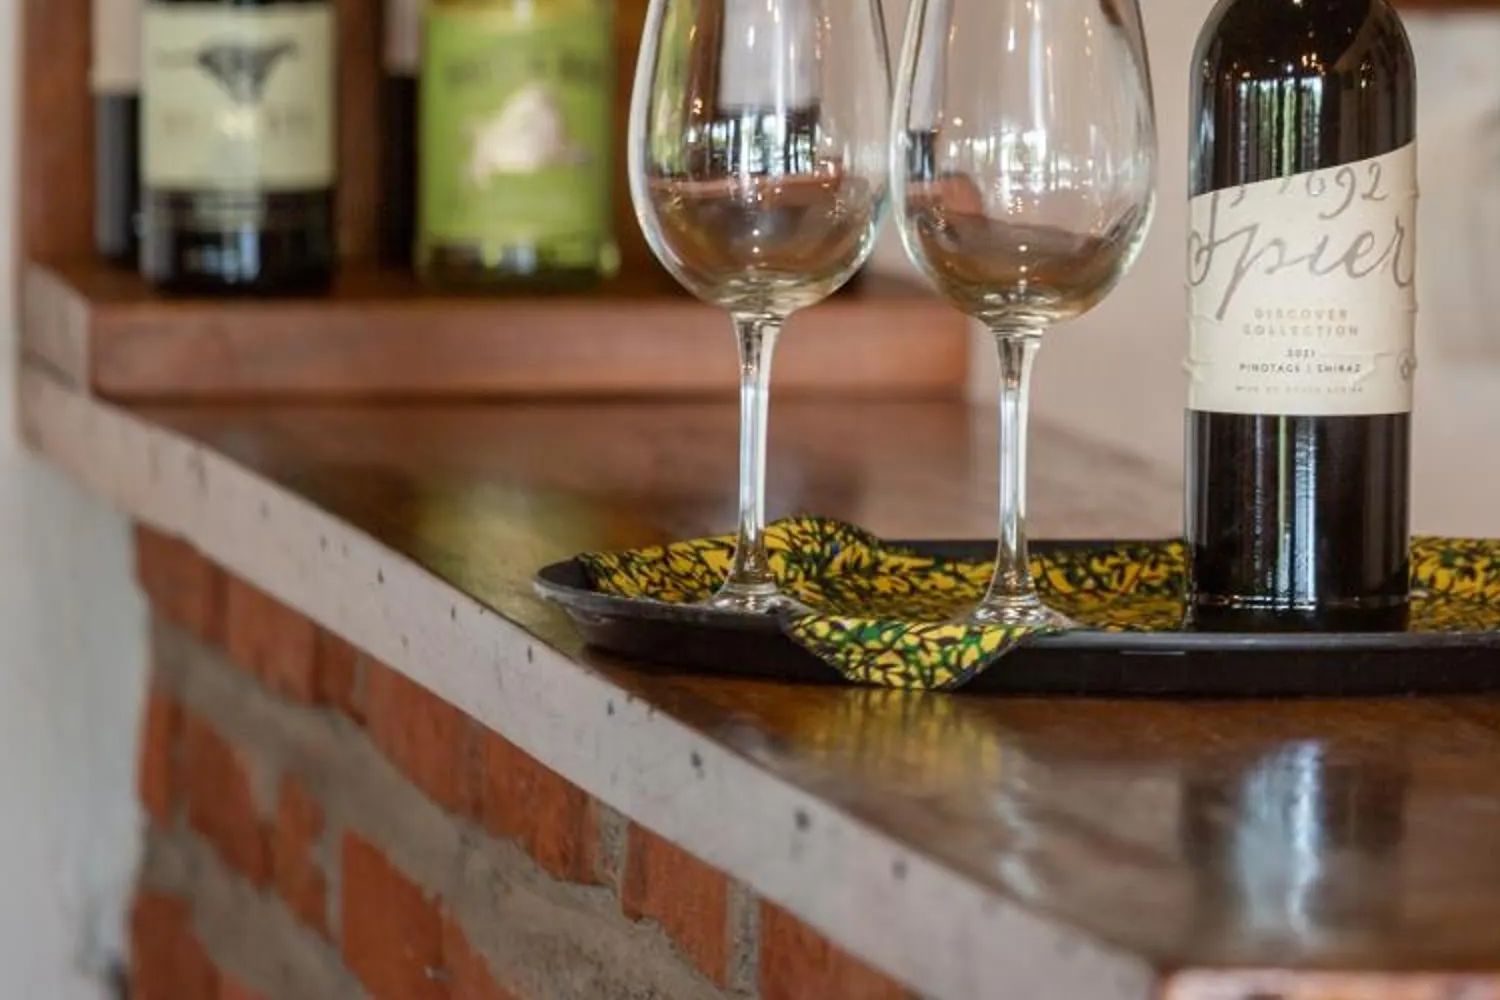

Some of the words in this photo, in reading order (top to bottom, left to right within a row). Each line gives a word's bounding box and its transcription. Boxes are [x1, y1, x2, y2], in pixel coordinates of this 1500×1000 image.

[1254, 308, 1348, 320] DISCOVER
[1243, 323, 1359, 337] COLLECTION
[1239, 362, 1301, 374] PINOTAGE
[1317, 362, 1362, 374] SHIRAZ
